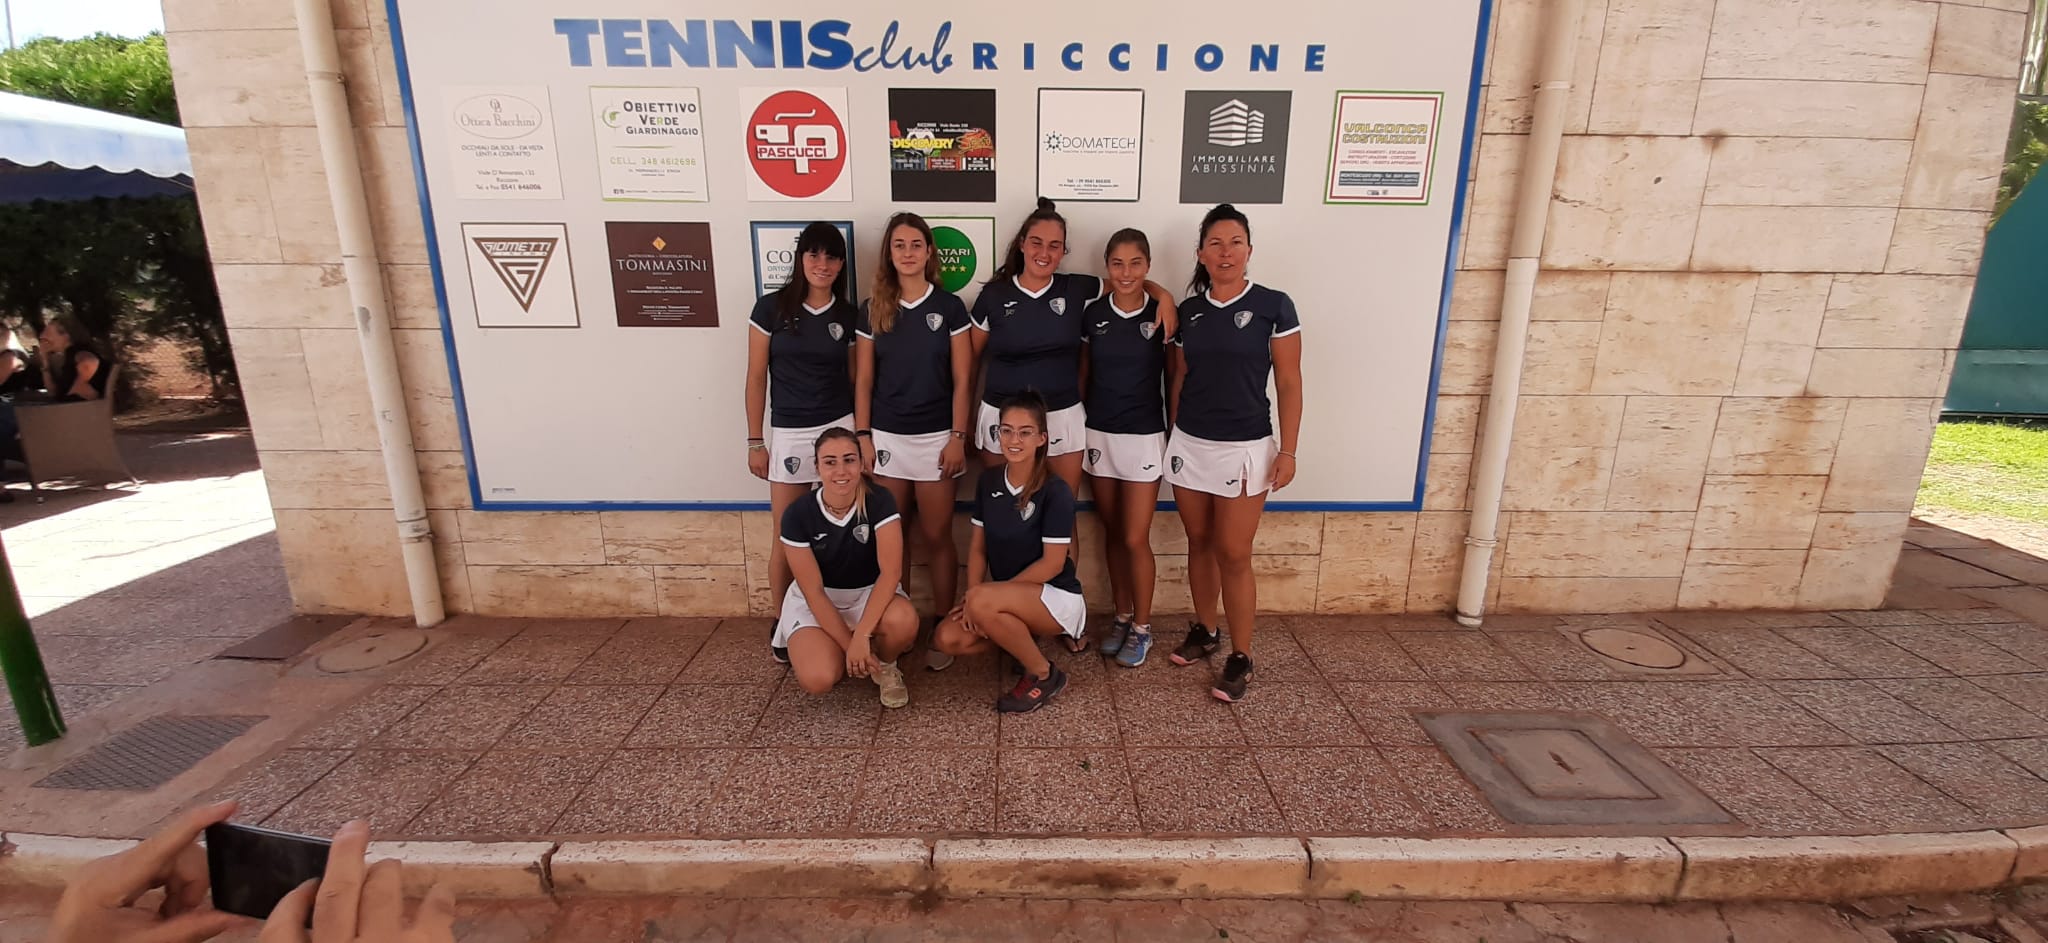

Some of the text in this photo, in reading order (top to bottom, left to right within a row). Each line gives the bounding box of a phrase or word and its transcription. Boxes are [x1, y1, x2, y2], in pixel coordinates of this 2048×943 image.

[554, 18, 1325, 73] TENNIS club RICCIONE
[623, 100, 697, 114] OBIETTIVO
[639, 114, 679, 126] VERDE
[626, 126, 699, 136] GIARDINAGGIO
[1344, 123, 1428, 134] VALCONCA
[893, 138, 954, 149] DISCOVERY
[1062, 137, 1136, 149] DOMATECH
[759, 147, 827, 158] PASCUCCI
[1192, 155, 1276, 163] IMMOBILIARE
[1191, 164, 1276, 174] ABISSINIA
[616, 258, 707, 272] TOMMASINI
